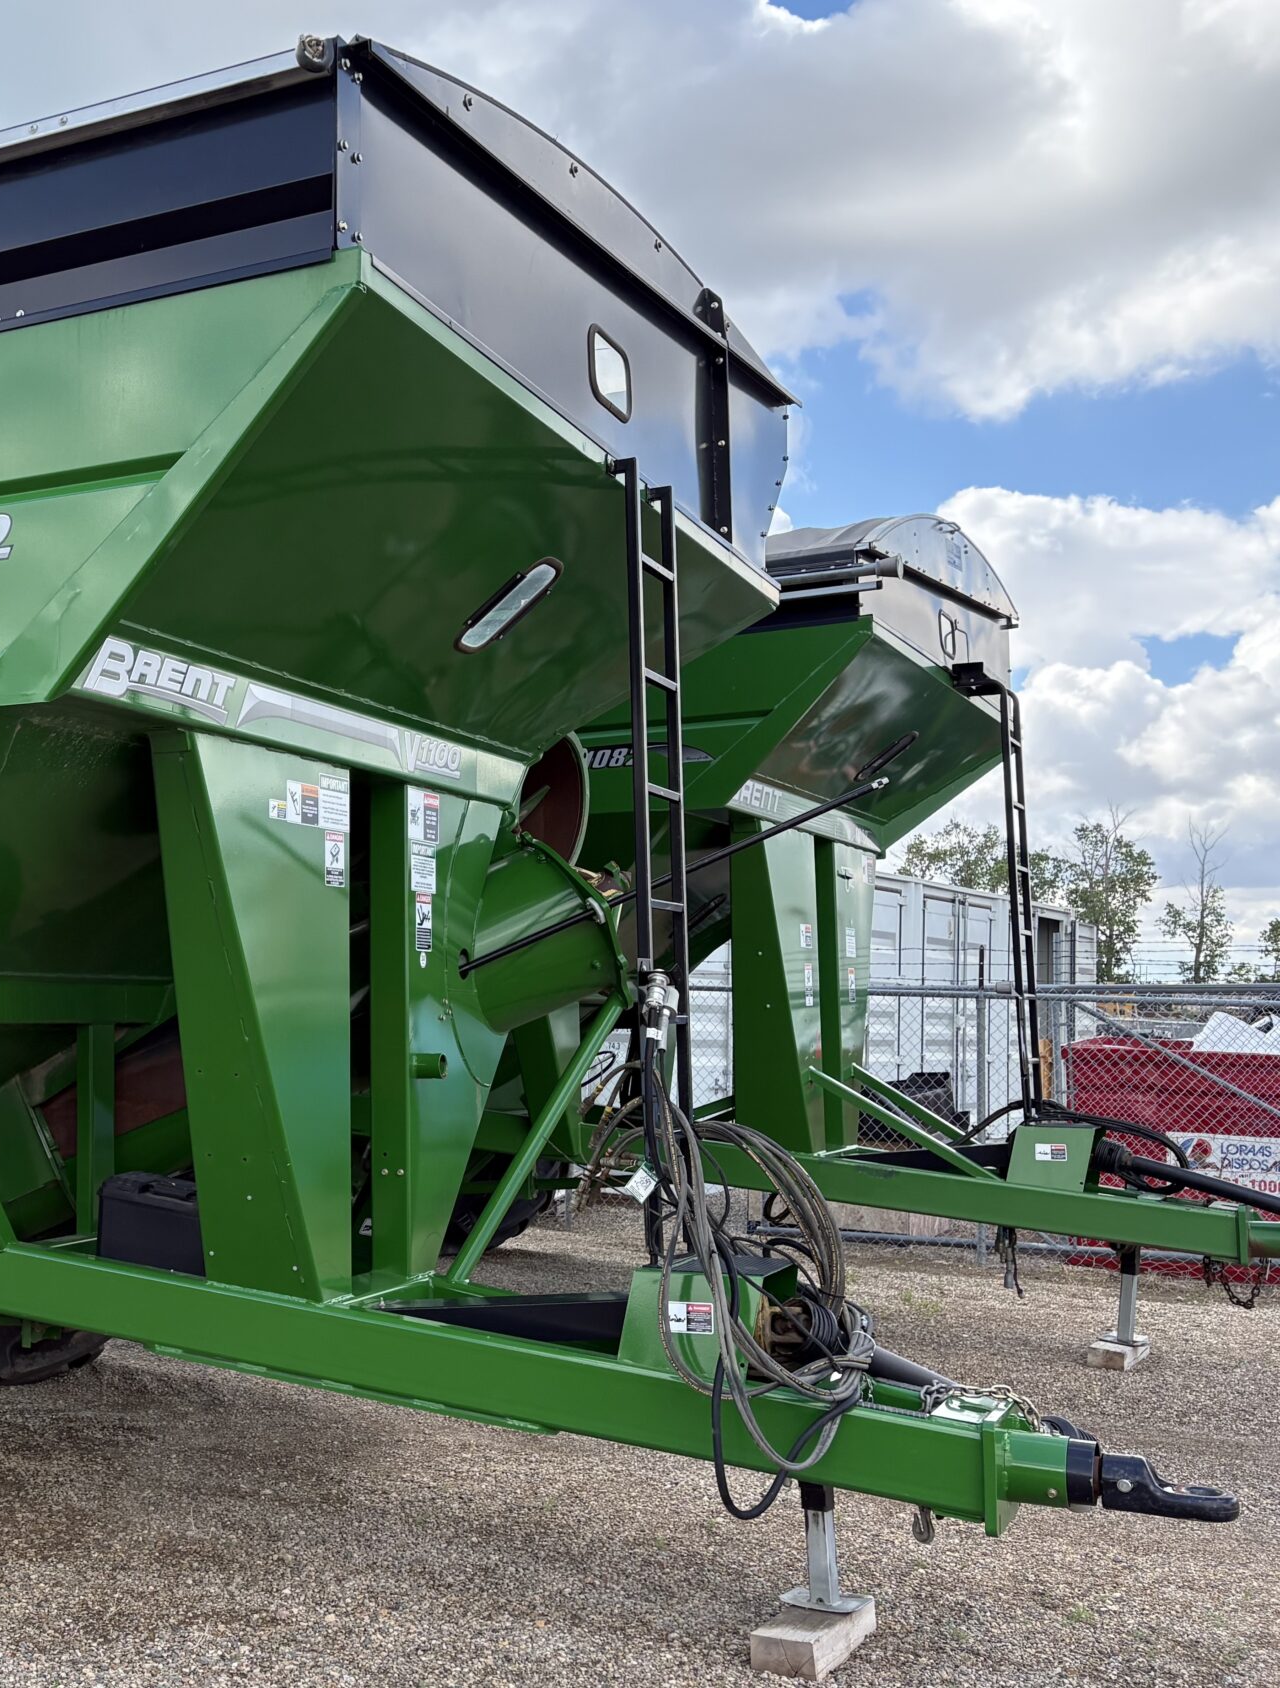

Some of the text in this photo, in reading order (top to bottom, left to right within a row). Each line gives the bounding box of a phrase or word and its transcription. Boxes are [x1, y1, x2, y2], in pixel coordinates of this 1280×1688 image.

[83, 636, 237, 708] BRENT
[404, 731, 461, 772] V1100
[734, 779, 783, 813] RENT
[1220, 1143, 1272, 1157] LORAAS
